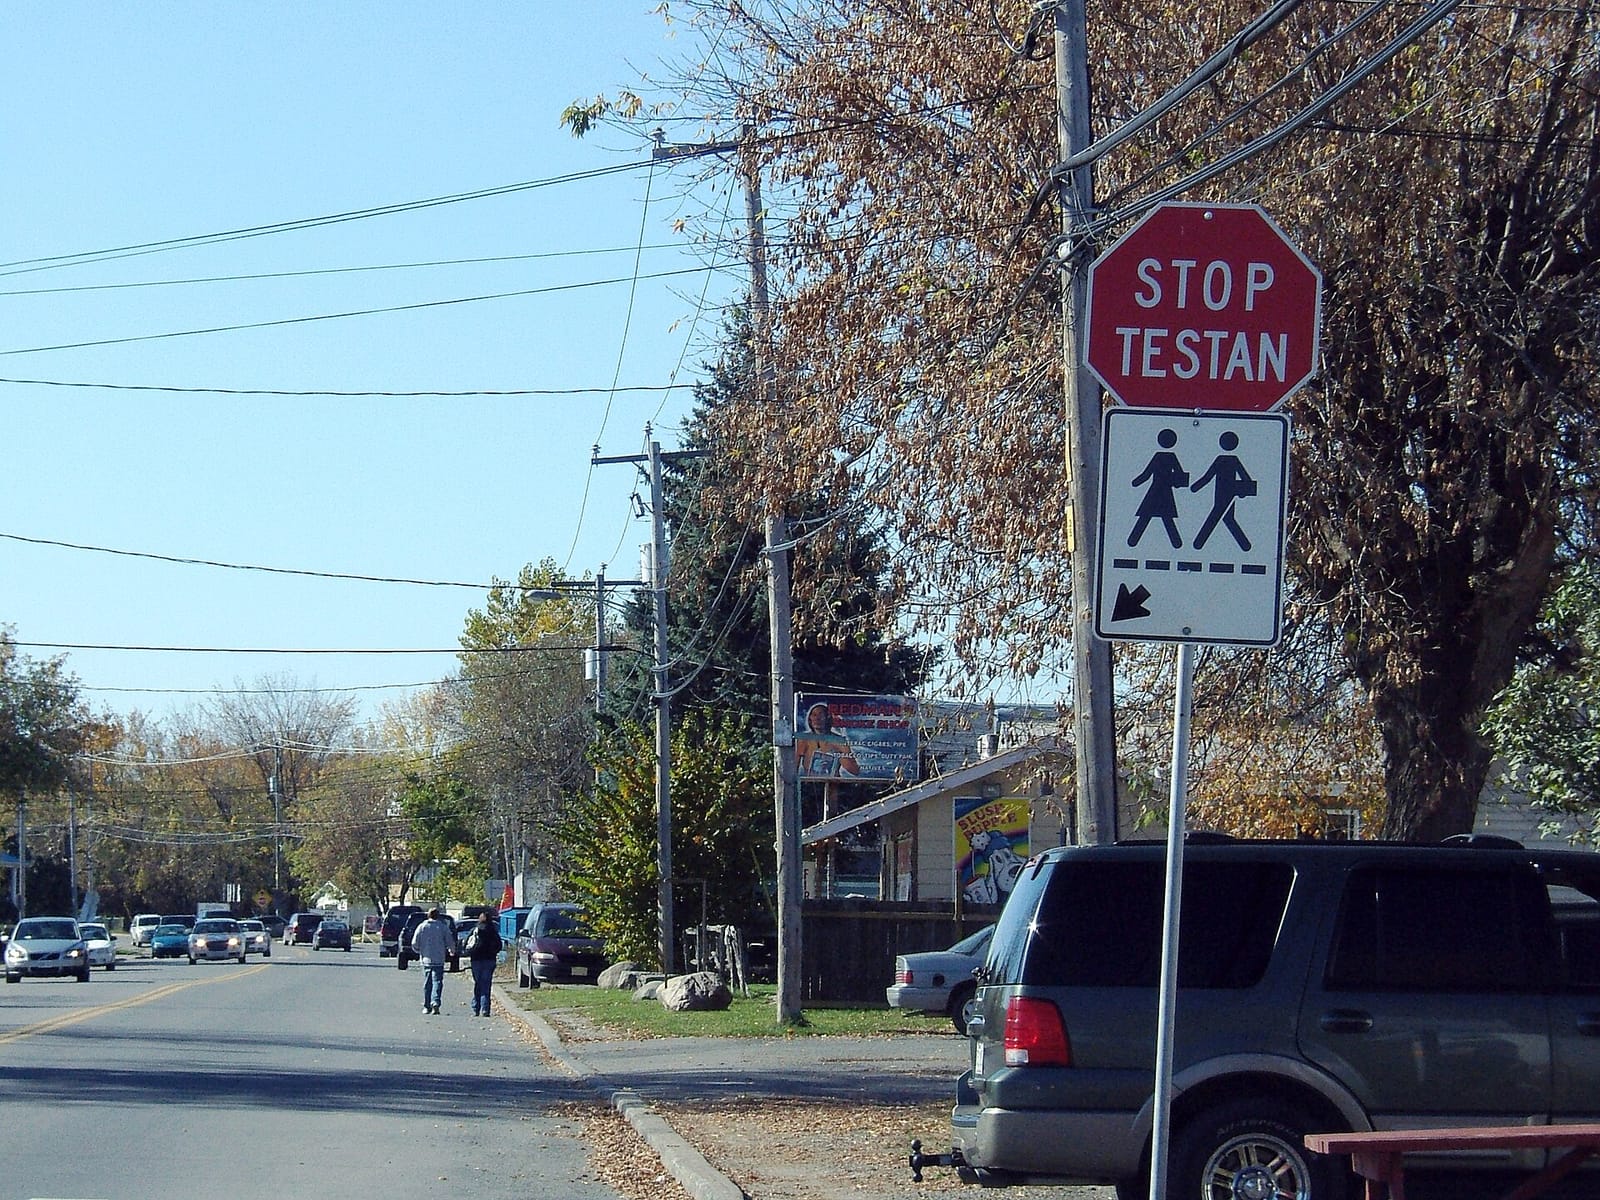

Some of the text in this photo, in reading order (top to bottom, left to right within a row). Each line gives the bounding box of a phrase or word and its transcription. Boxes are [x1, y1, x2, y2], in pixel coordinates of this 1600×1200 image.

[1134, 257, 1275, 311] STOP
[1115, 327, 1288, 382] TESTAN
[877, 719, 909, 728] SHOP
